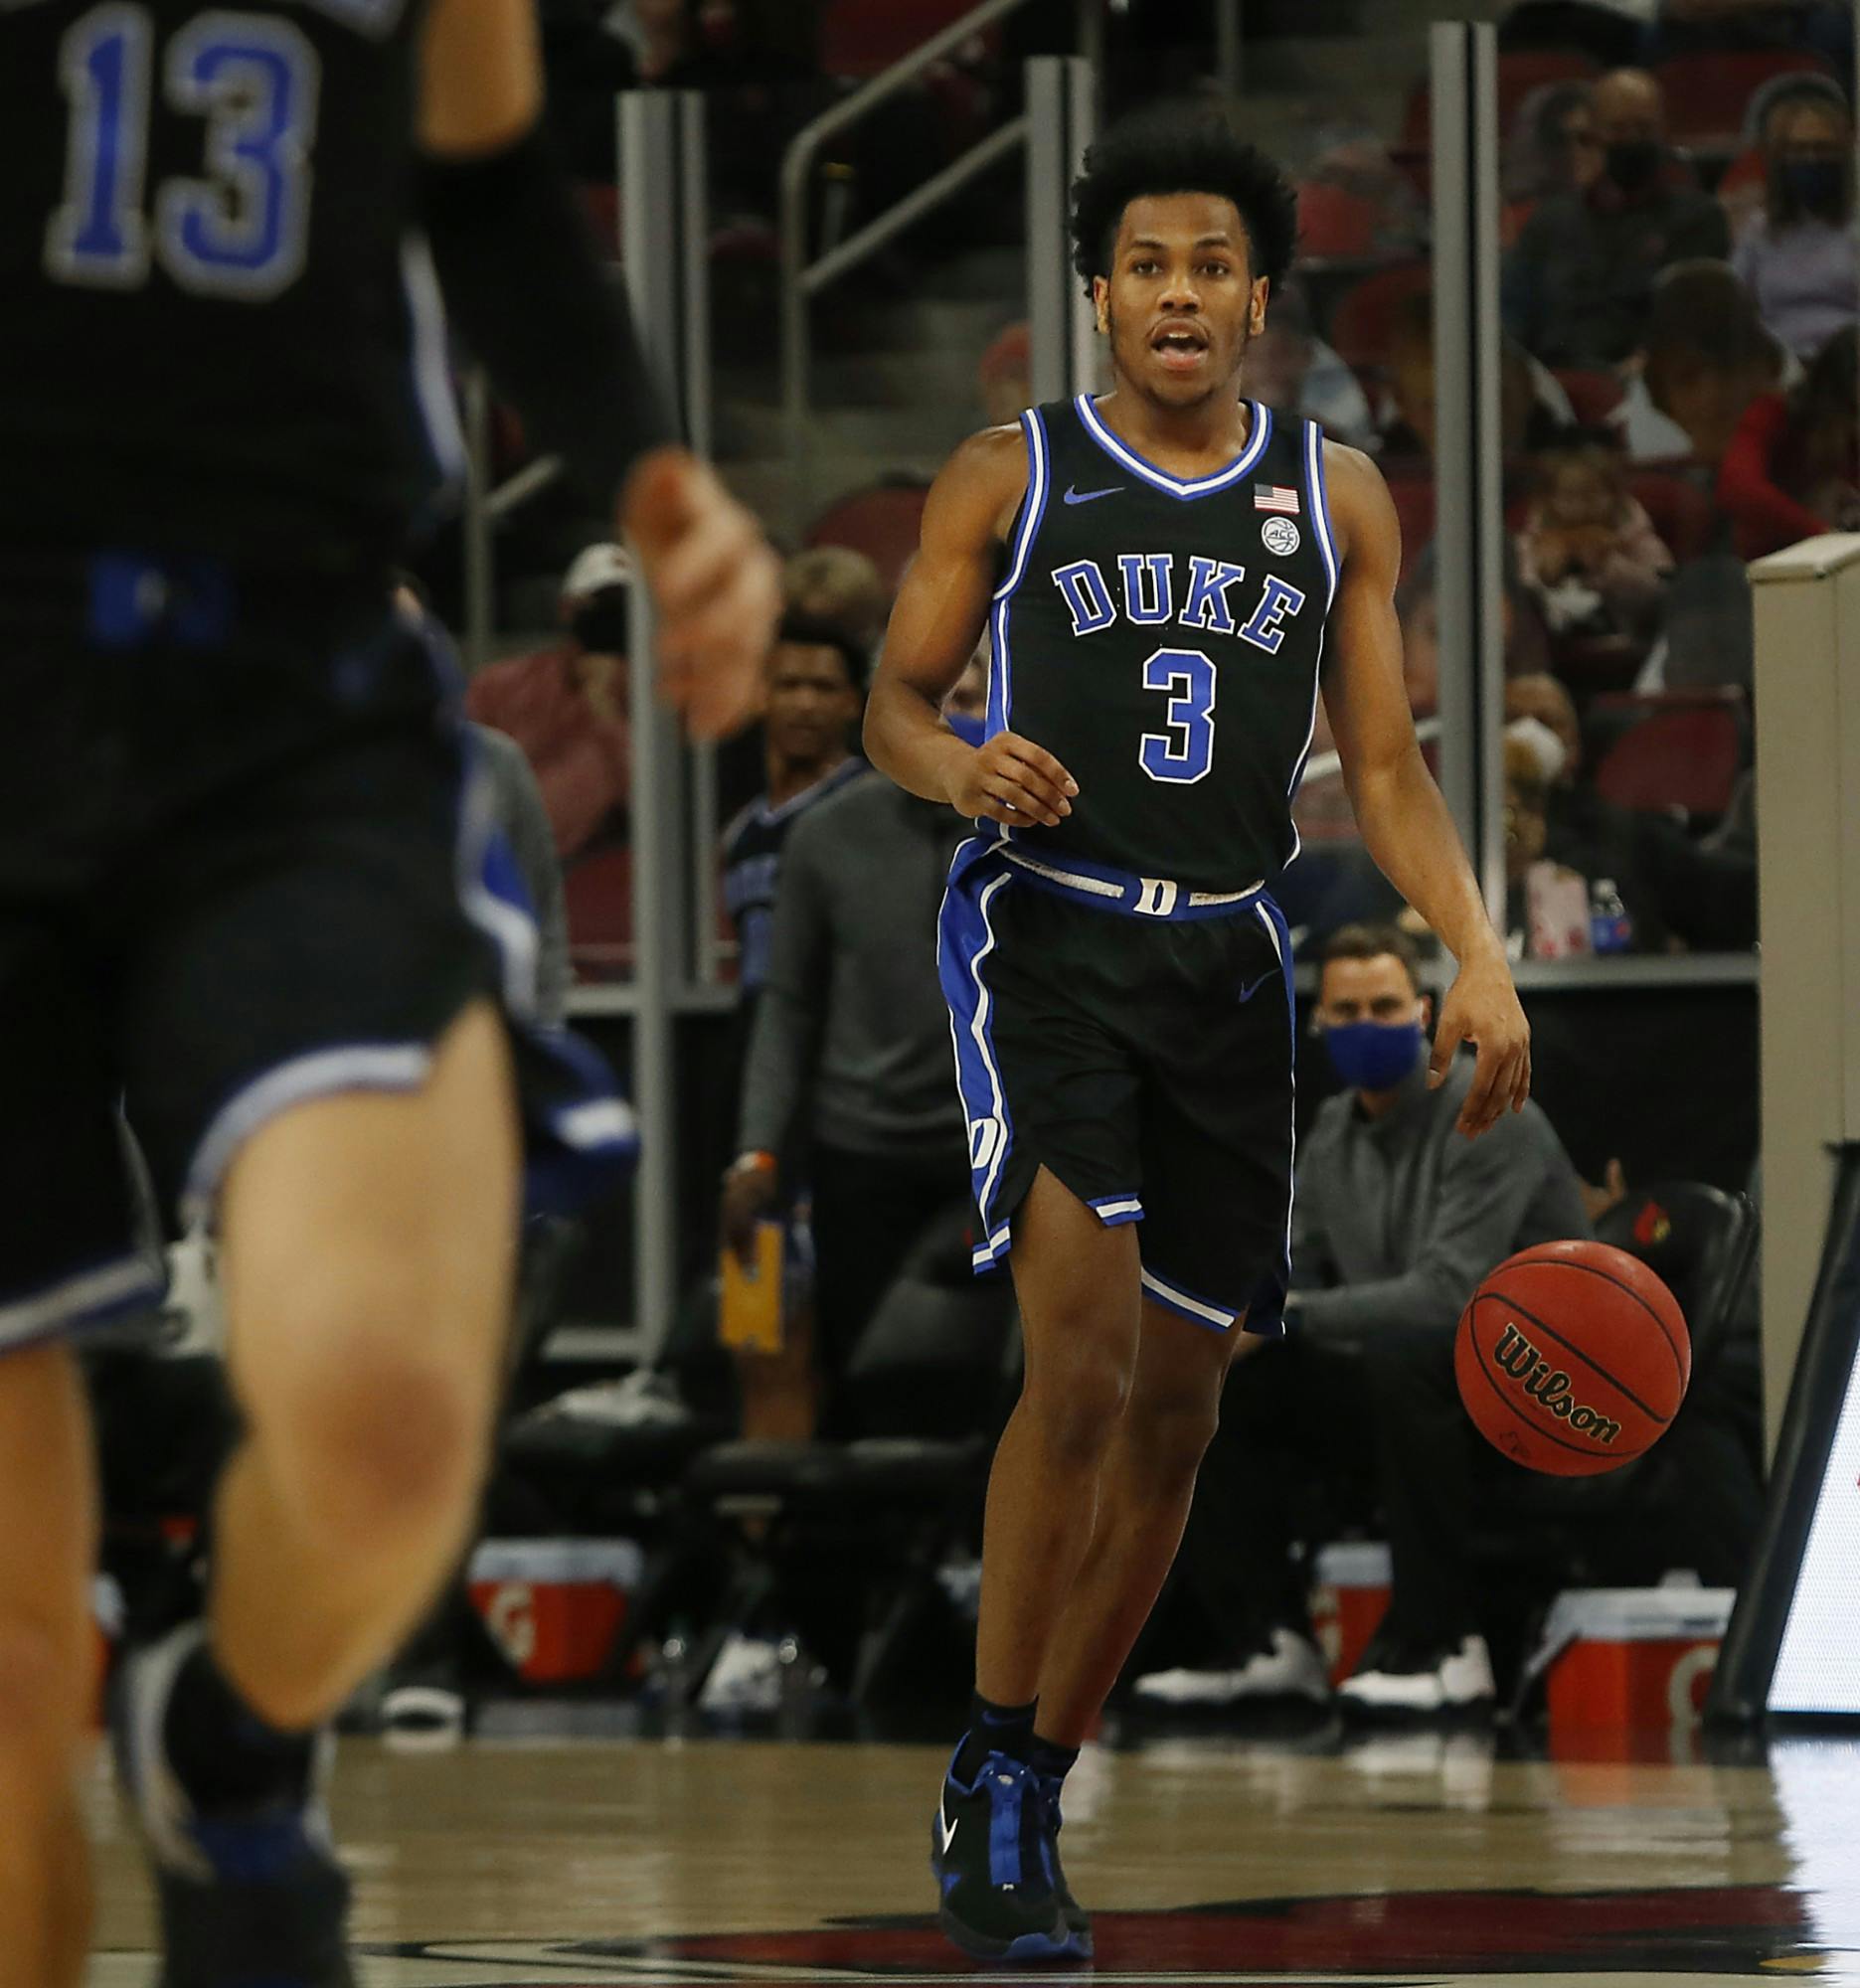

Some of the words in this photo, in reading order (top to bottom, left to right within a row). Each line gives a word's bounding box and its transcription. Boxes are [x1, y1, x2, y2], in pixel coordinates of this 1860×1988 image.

[45, 5, 321, 297] 13
[1268, 529, 1295, 542] ACC
[1051, 554, 1305, 654] DUKE
[1139, 647, 1217, 783] 3
[1133, 877, 1178, 915] D
[1494, 1322, 1621, 1444] Wilson
